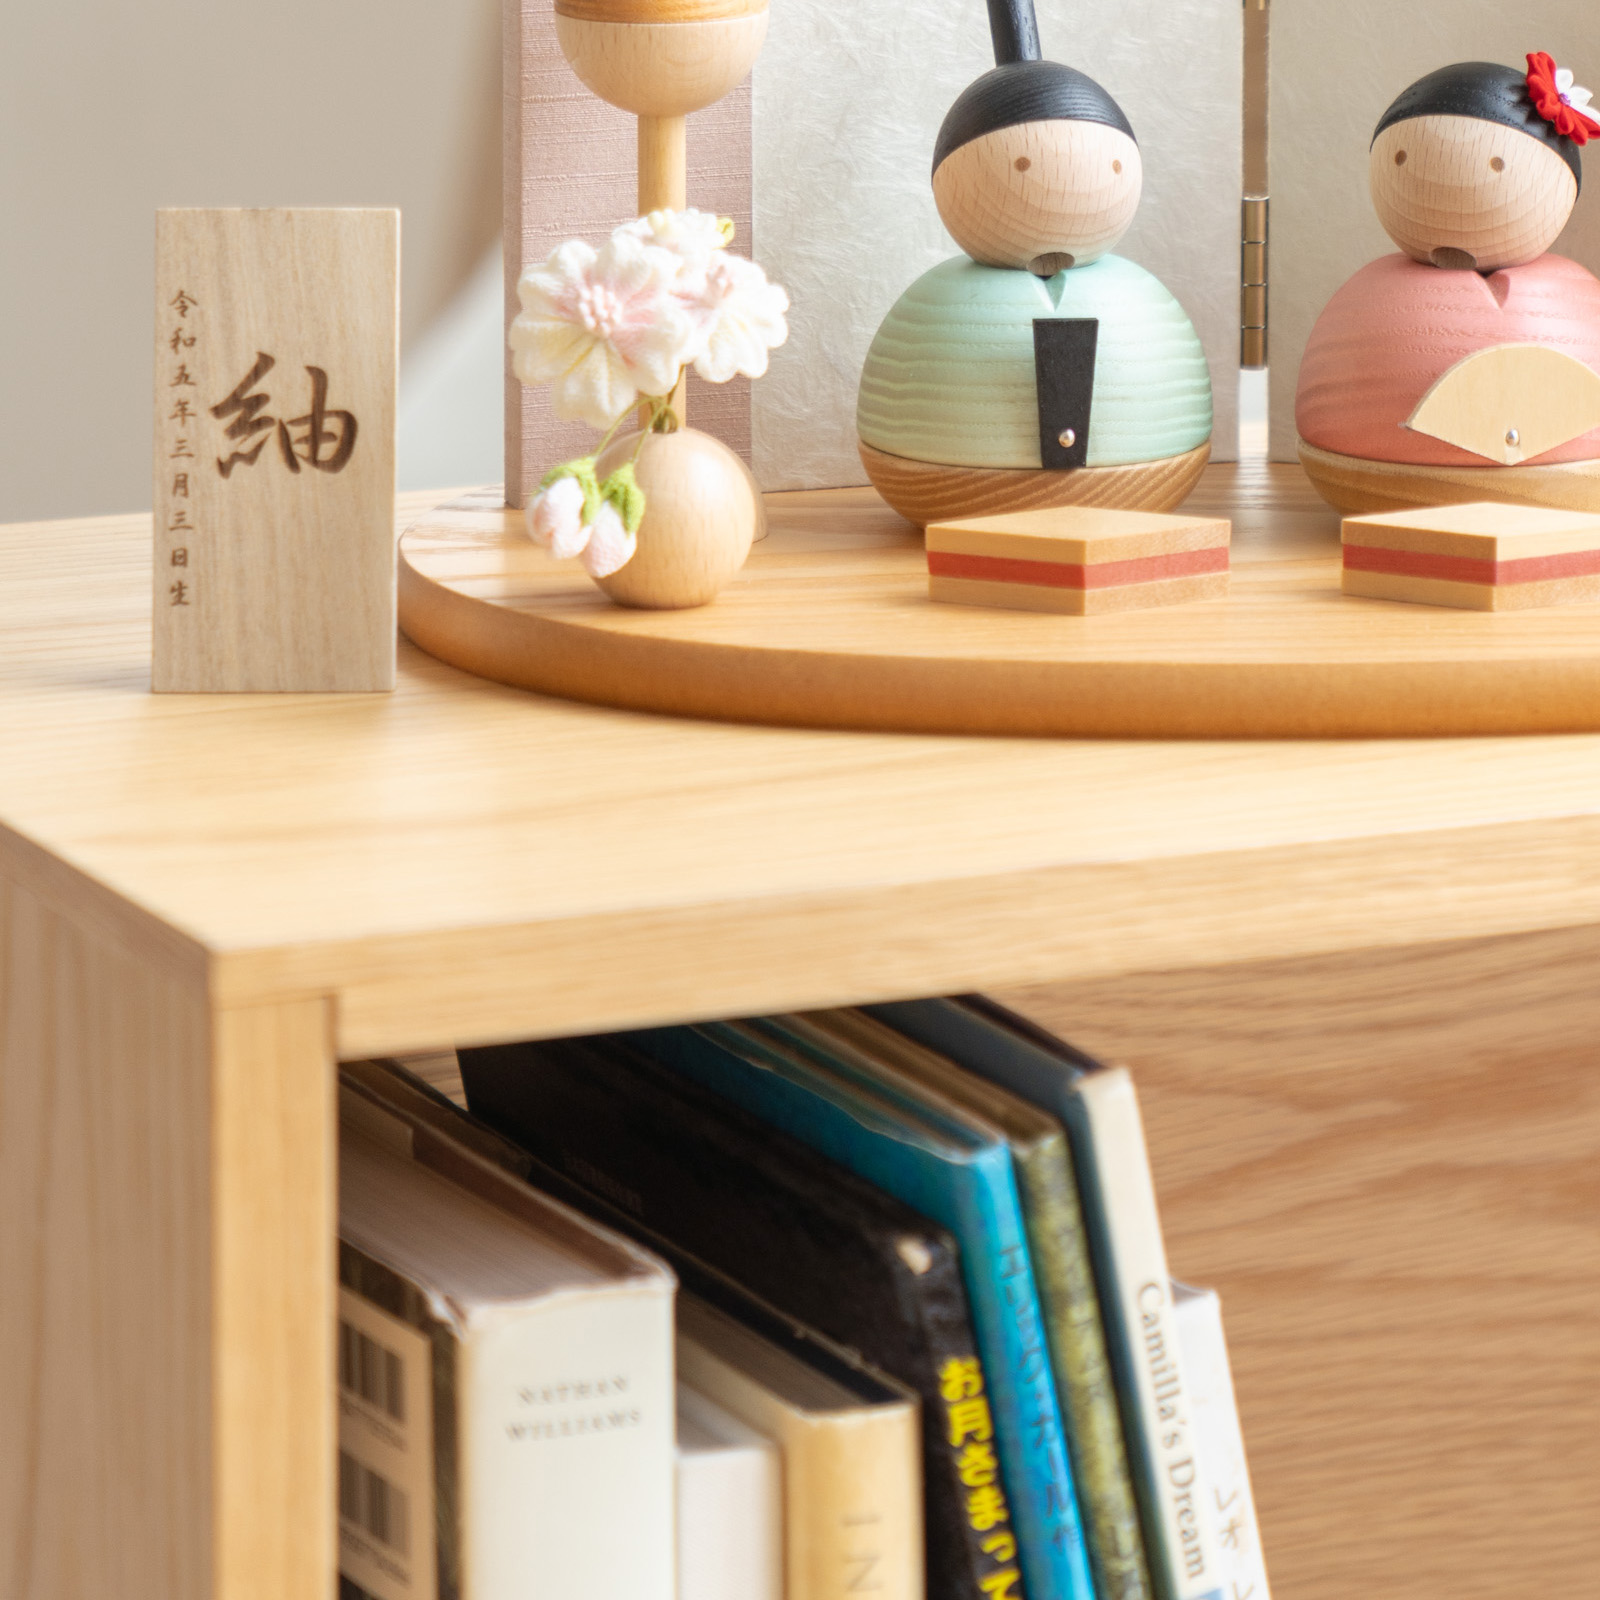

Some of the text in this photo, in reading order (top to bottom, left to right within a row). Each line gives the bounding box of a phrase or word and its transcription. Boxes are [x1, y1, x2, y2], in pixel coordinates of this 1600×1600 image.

[168, 289, 199, 607] 令和五年三月三日生
[209, 351, 359, 479] 紬
[508, 1410, 641, 1441] WILLIAMS
[518, 1376, 628, 1405] NATHAN
[1136, 1282, 1205, 1578] Camilla's Dream
